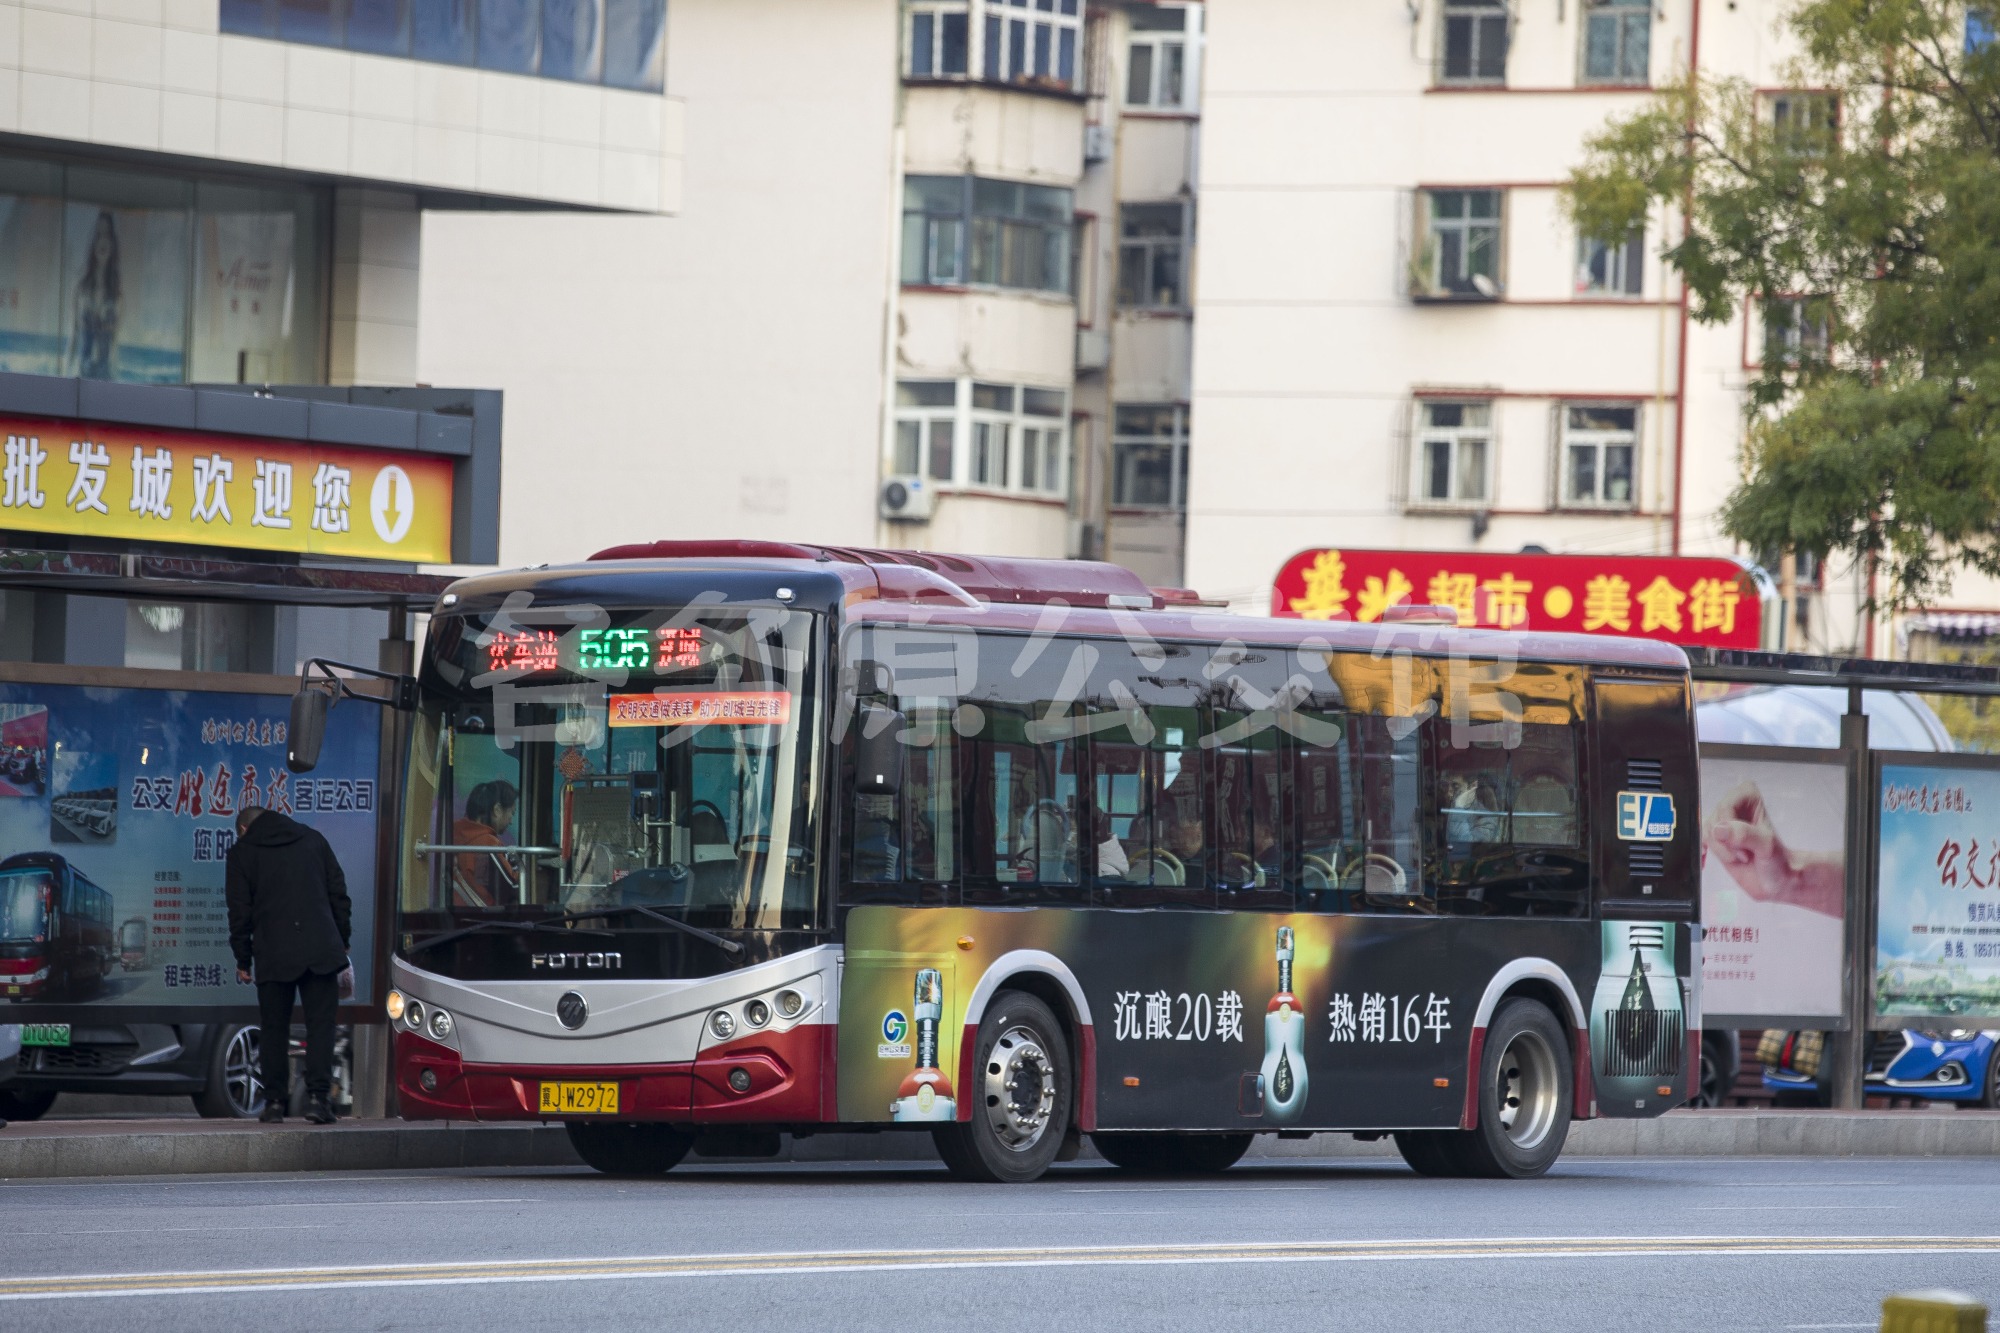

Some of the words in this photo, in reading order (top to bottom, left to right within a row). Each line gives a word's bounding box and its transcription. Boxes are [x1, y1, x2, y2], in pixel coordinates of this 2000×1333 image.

[2, 435, 351, 533] 批发城欢迎您
[580, 628, 649, 668] 505
[616, 700, 693, 719] 文明交通做表率
[699, 699, 781, 718] 助力创城当先锋
[1619, 795, 1653, 838] EV
[531, 952, 622, 969] FOTON
[1114, 990, 1244, 1042] 沉酿20载
[1328, 992, 1452, 1044] 热销16年
